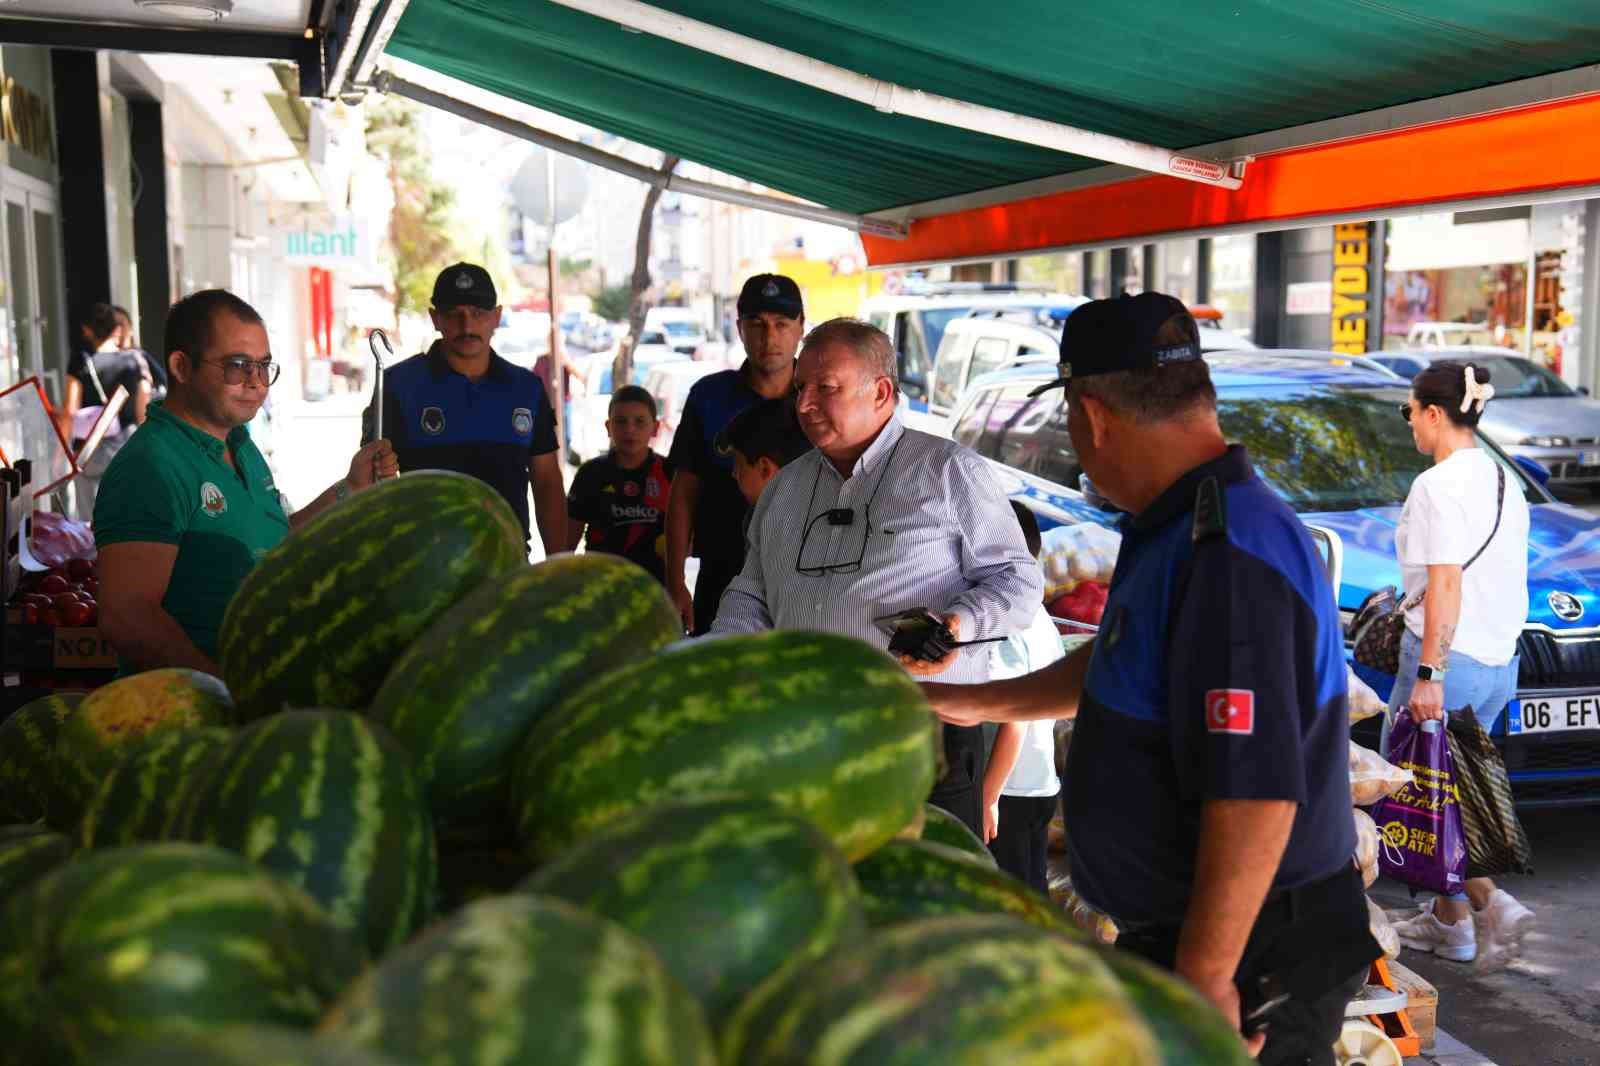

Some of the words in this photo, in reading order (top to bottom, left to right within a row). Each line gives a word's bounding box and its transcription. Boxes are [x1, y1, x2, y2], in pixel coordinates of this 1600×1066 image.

[611, 503, 658, 519] beko
[1523, 702, 1551, 729] 06
[1410, 827, 1438, 845] SIFIR
[1407, 839, 1436, 857] ATIK
